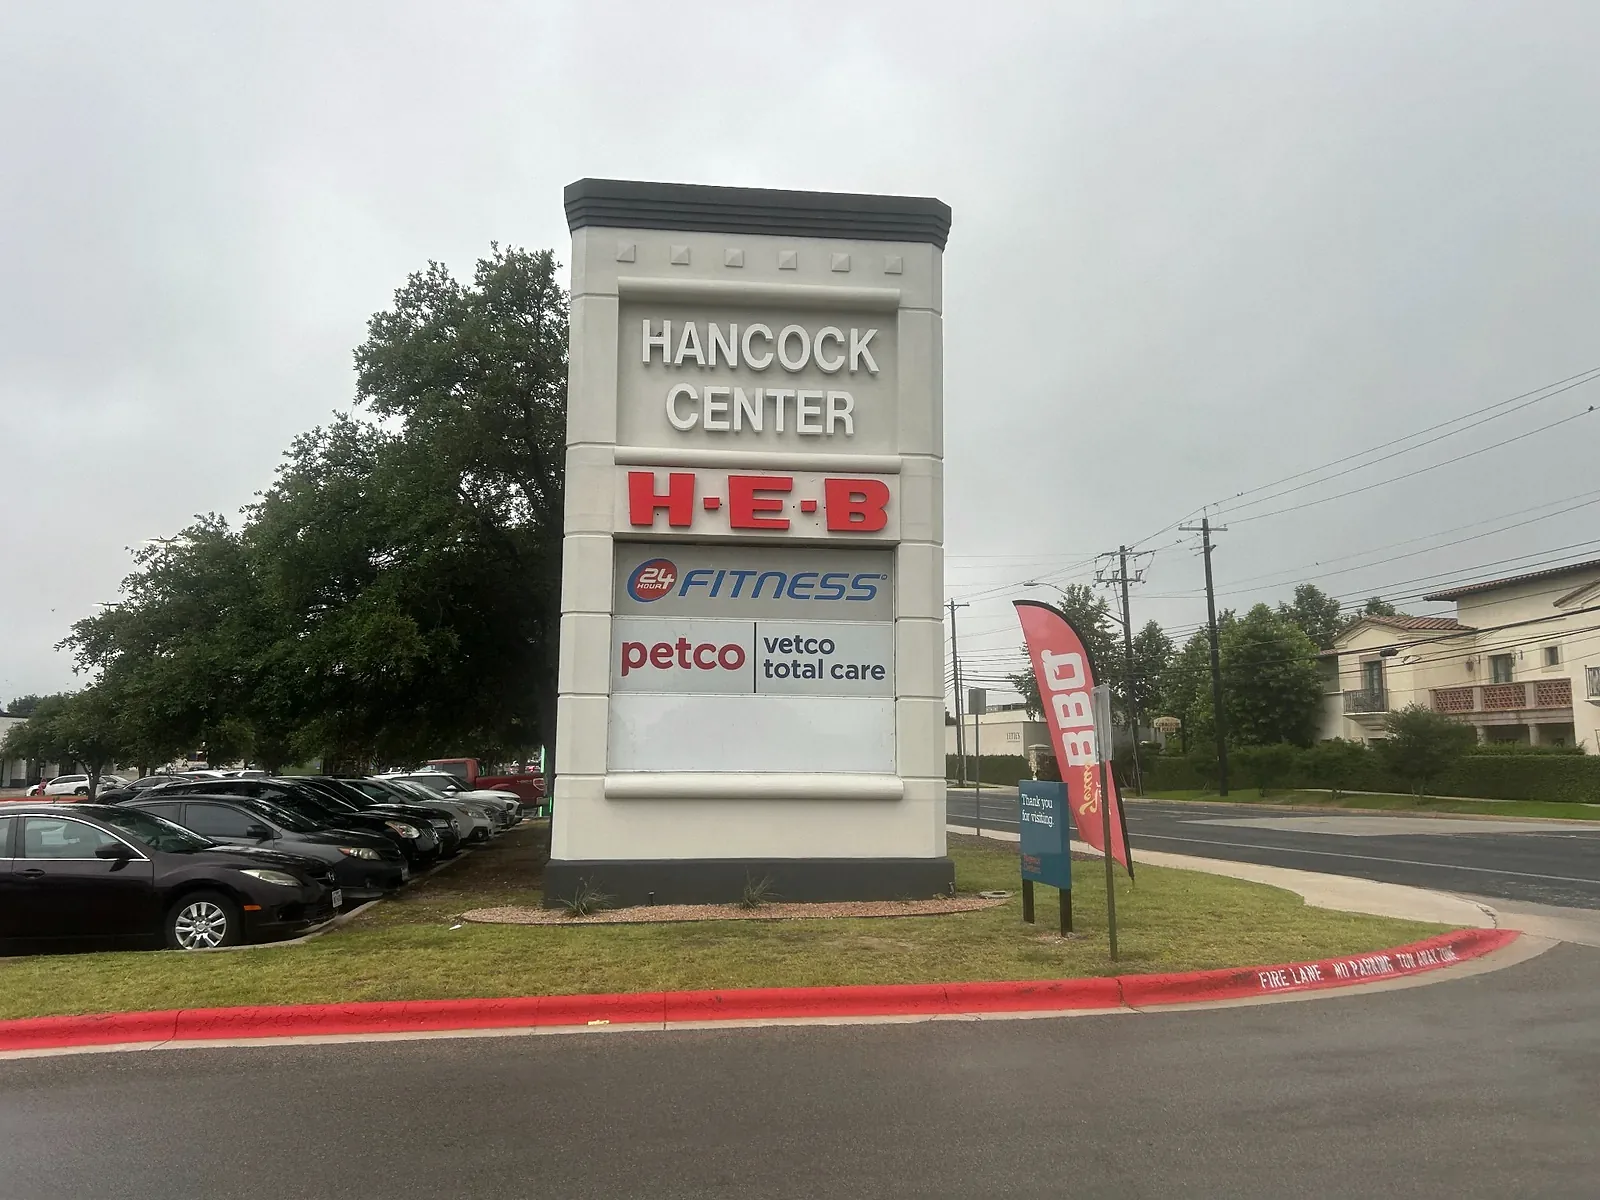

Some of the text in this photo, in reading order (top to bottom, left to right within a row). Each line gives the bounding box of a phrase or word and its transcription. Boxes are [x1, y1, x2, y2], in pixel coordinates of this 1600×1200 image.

[641, 318, 880, 376] HANCOCK
[665, 382, 856, 437] CENTER
[639, 567, 675, 590] 24
[678, 569, 882, 602] FITNESS
[621, 637, 746, 677] petco
[763, 634, 836, 656] vetco
[763, 658, 886, 681] total care
[1021, 793, 1053, 810] Thank you
[1022, 809, 1031, 821] for
[1258, 970, 1290, 989] FIRE
[1288, 964, 1325, 984] LANE
[1331, 962, 1350, 979] NO
[1348, 954, 1394, 977] PARKING
[1395, 953, 1417, 969] TOW
